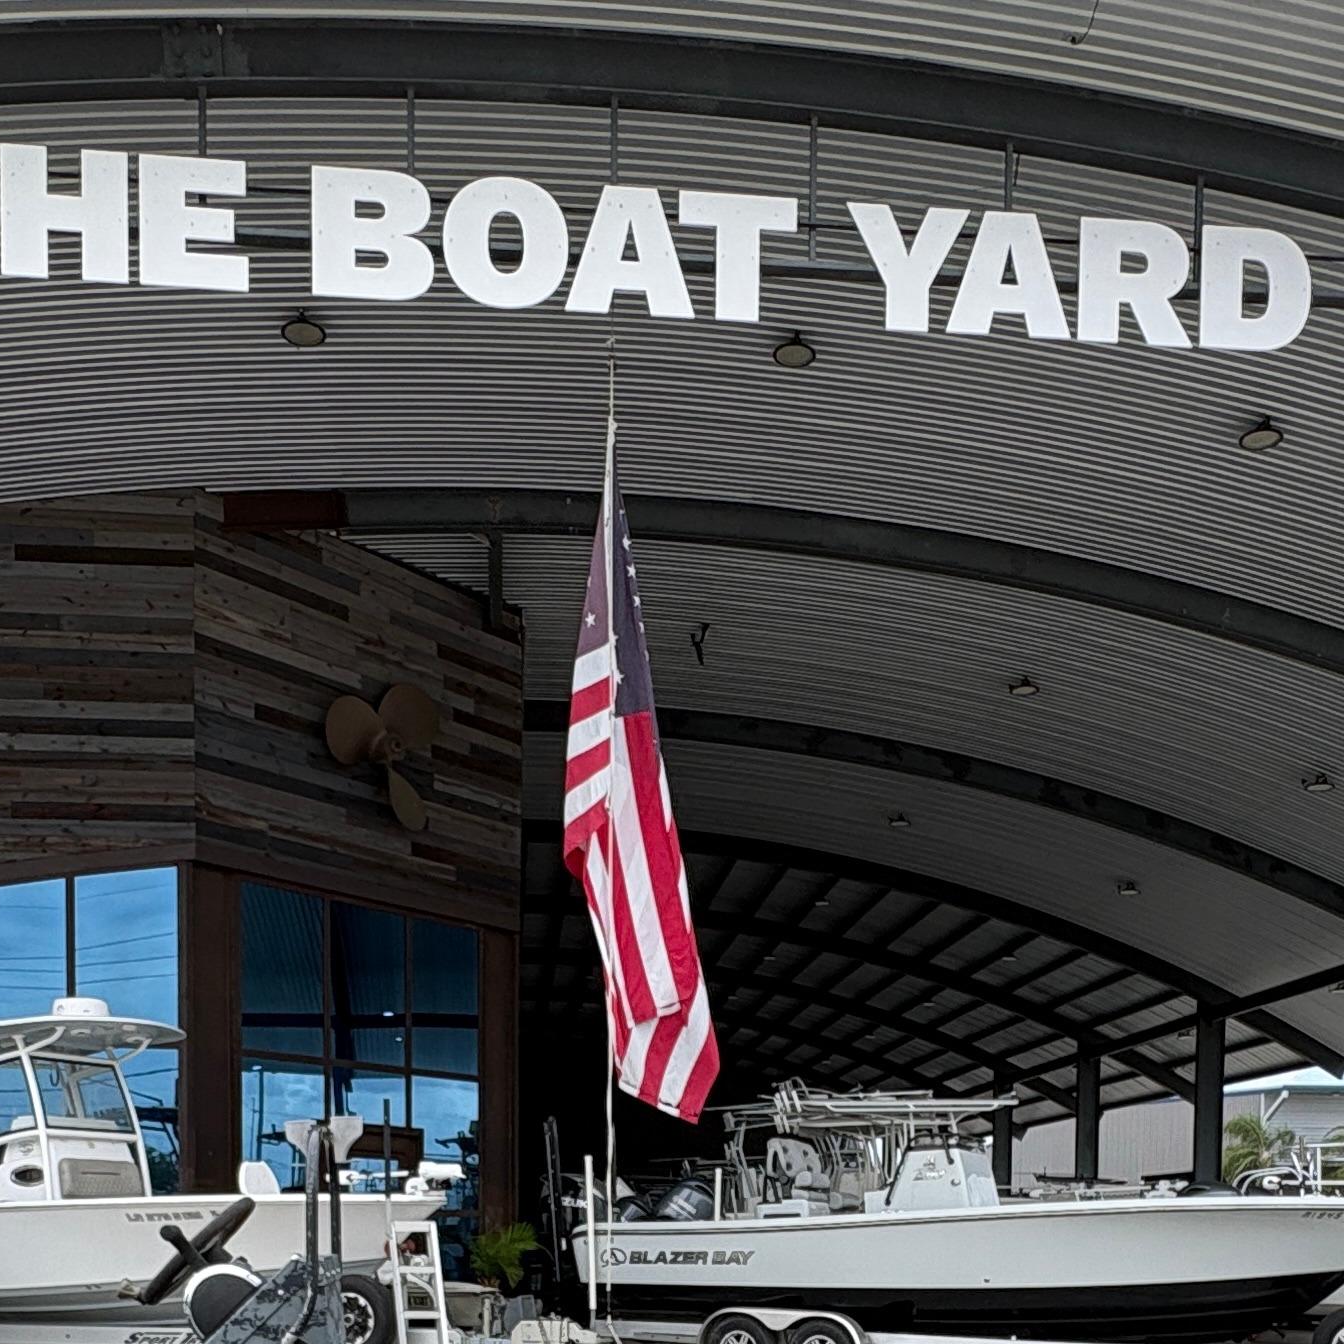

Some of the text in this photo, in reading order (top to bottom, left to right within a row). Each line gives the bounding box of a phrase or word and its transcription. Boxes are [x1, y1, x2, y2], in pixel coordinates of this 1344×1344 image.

[311, 165, 798, 322] BOAT
[846, 202, 1313, 351] YARD
[629, 1250, 755, 1265] BLAZER BAY
